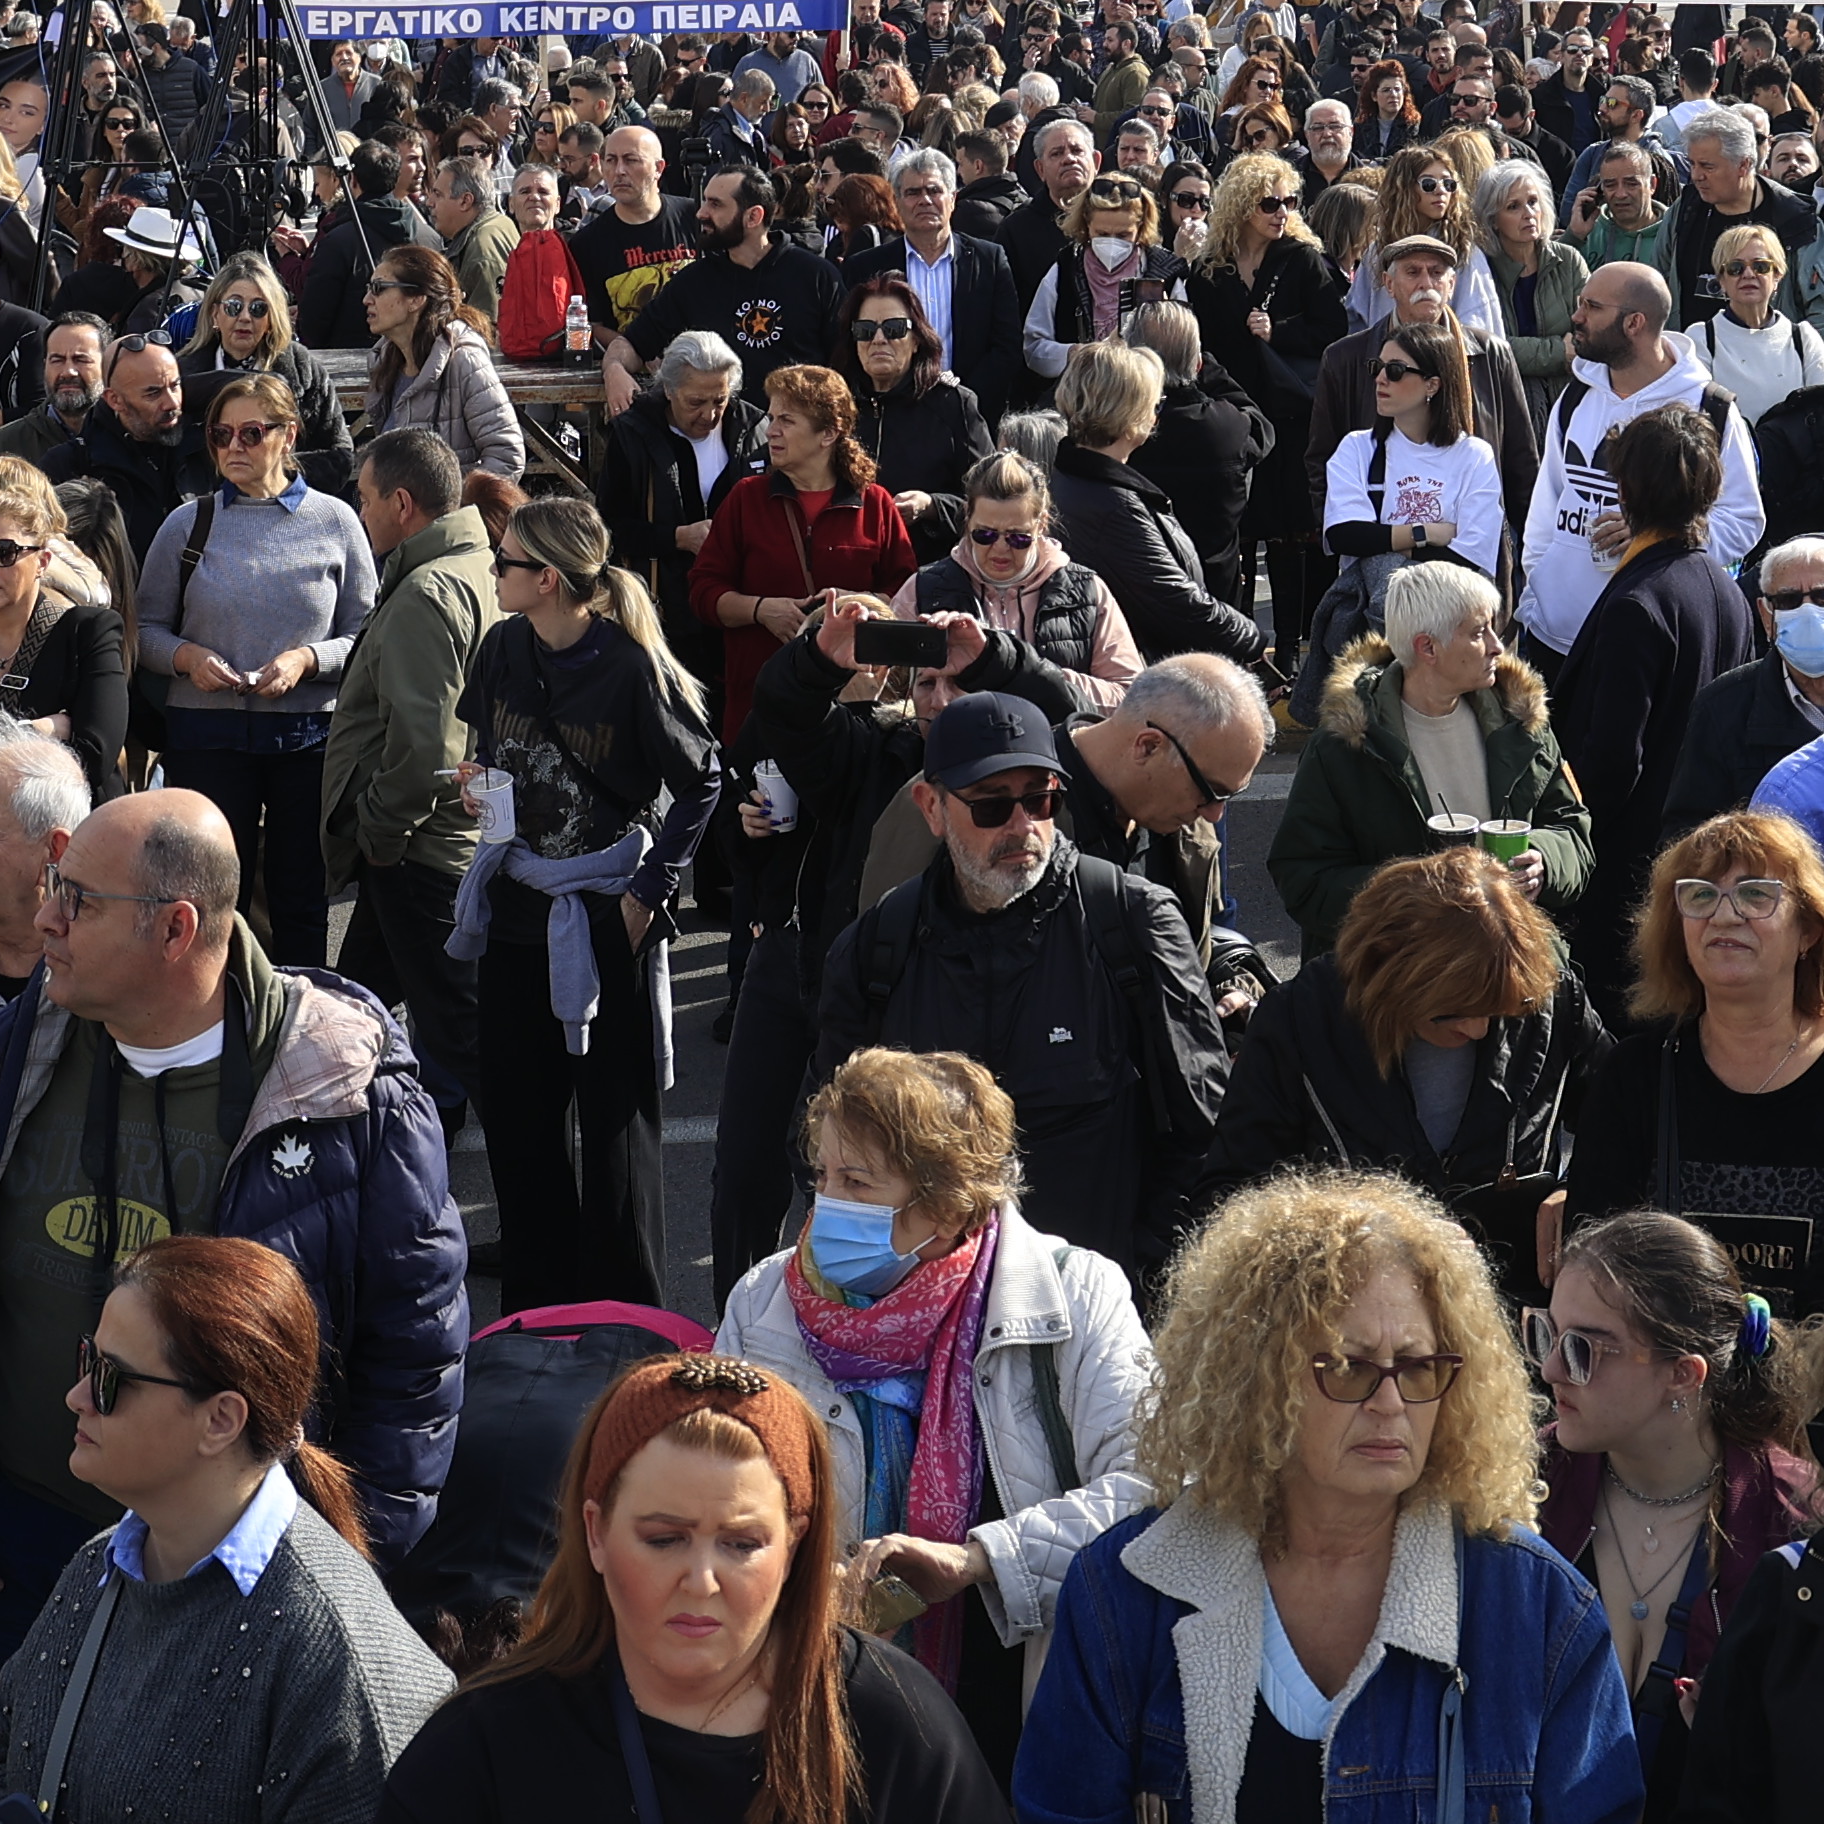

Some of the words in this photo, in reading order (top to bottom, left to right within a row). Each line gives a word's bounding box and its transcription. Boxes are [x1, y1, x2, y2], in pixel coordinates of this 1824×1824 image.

[307, 7, 483, 35] ΕΡΓΑΤΙΚΟ
[499, 4, 635, 33] ΚΕΝΤΡΟ
[652, 2, 803, 31] ΠΕΙΡΑΙΑ
